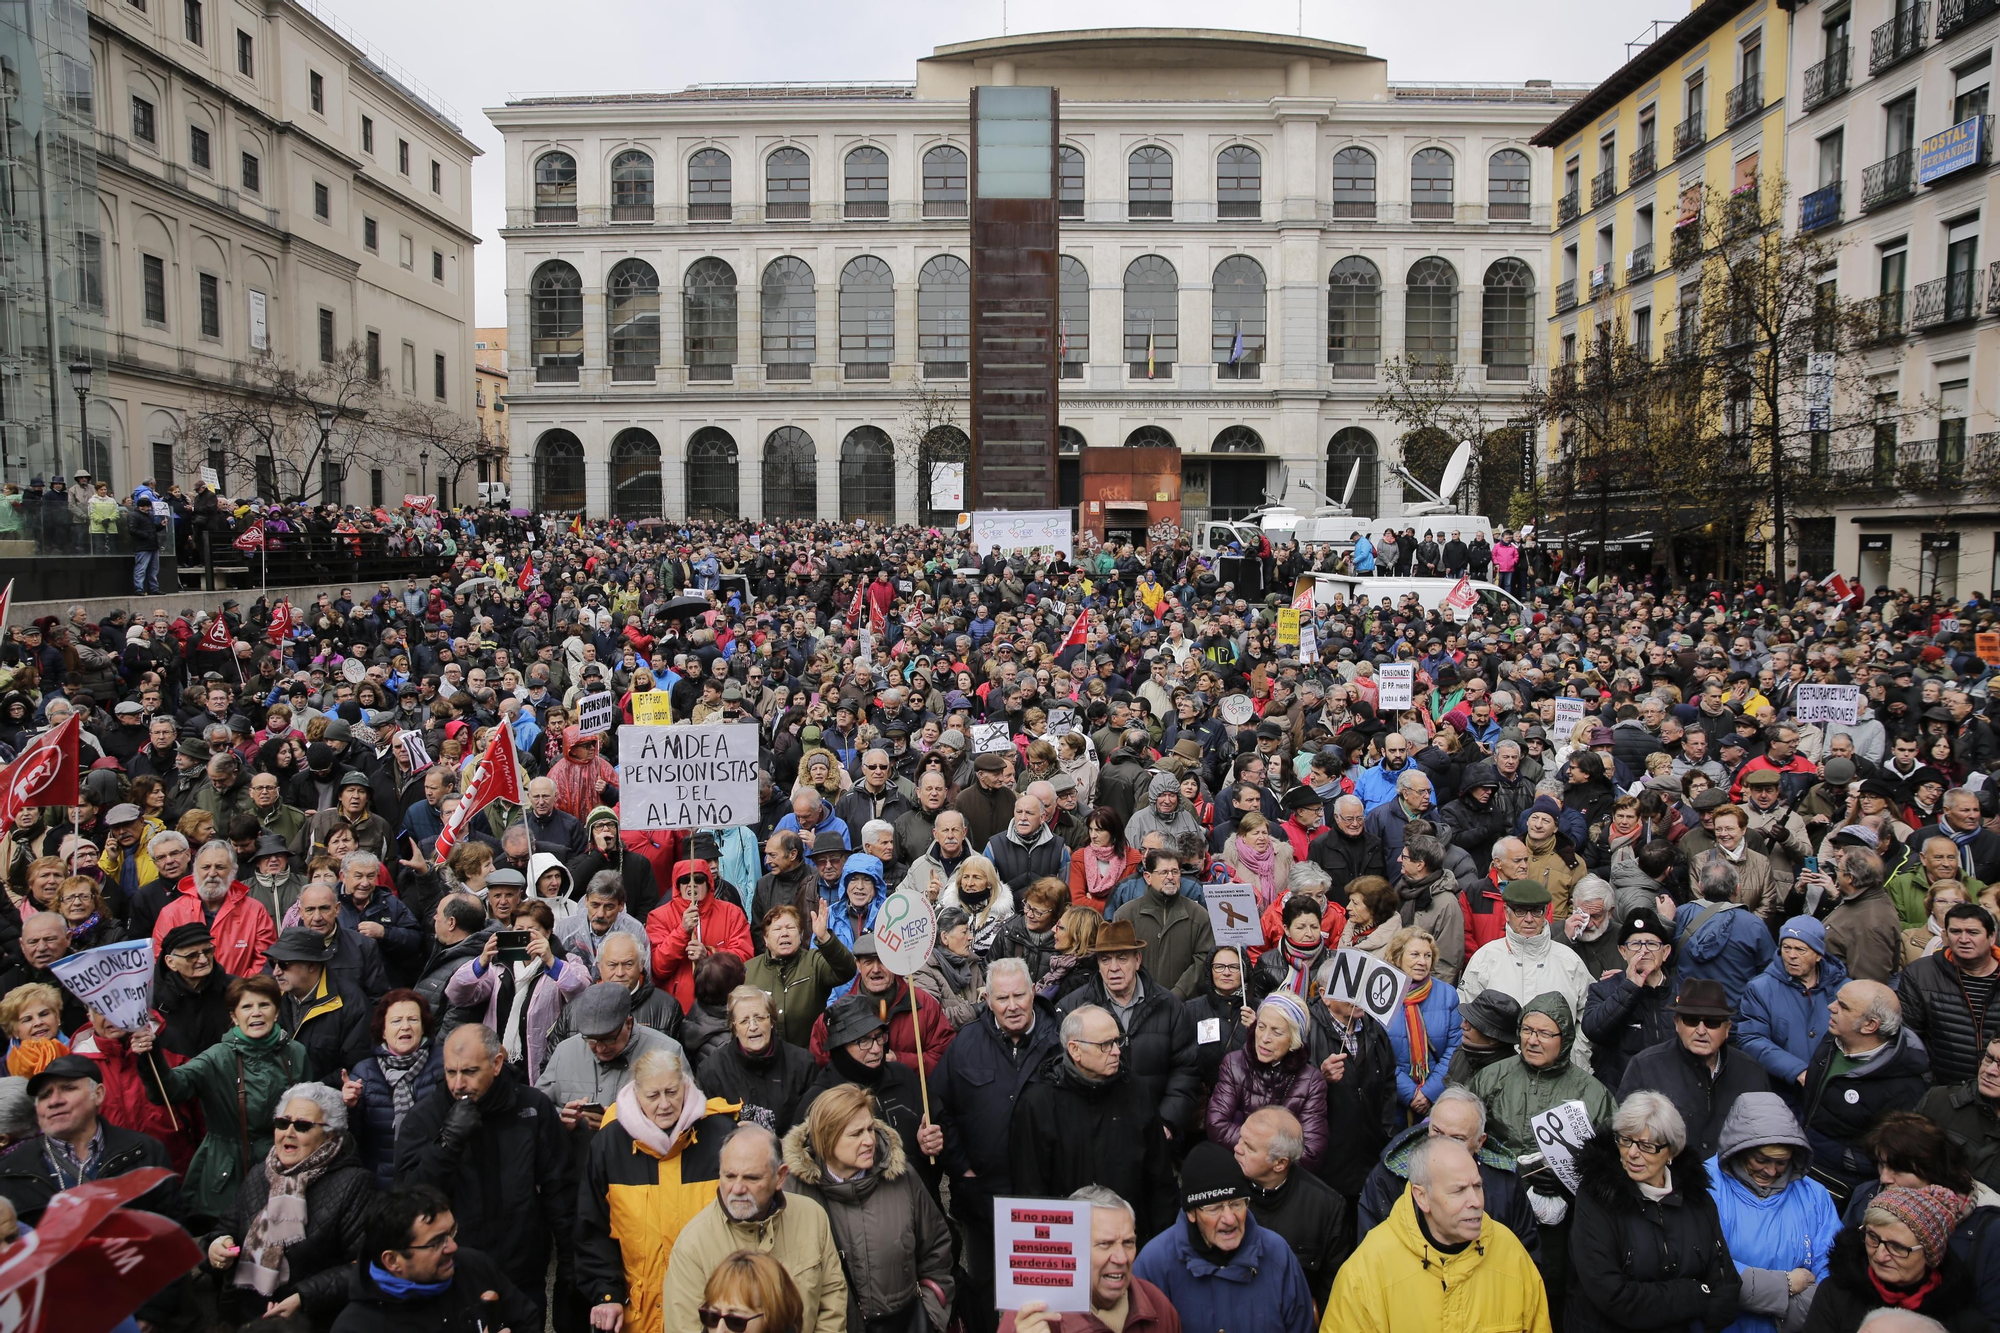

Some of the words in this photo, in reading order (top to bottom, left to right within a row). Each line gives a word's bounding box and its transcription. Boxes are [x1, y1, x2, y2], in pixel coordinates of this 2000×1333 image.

[1922, 125, 1968, 155] HOSTAL
[1922, 139, 1974, 170] FERNANDEZ
[1126, 401, 1168, 409] SUPERIOR
[1172, 401, 1183, 409] DE
[1223, 401, 1234, 409] DE
[1237, 401, 1274, 409] MADRID
[1800, 688, 1830, 700] RESTAURAR
[1830, 688, 1837, 700] EL
[1840, 688, 1857, 701] VALOR
[580, 695, 611, 715] ¡PENSIÓN
[642, 713, 652, 724] gran
[1799, 706, 1806, 719] DE
[1808, 706, 1819, 719] LAS
[580, 717, 601, 731] JUSTA
[625, 760, 758, 785] PENSIONISTAS
[675, 785, 717, 800] DEL
[647, 802, 732, 826] ALAMO
[901, 917, 928, 941] MERP
[1328, 952, 1398, 1015] NO
[1564, 1105, 1572, 1115] ES
[1573, 1107, 1582, 1116] SU
[1549, 1156, 1558, 1166] no
[1556, 1166, 1569, 1180] hay
[1187, 1187, 1235, 1203] GREENPEACE
[1011, 1211, 1020, 1220] Si
[1041, 1214, 1073, 1223] pagas
[1035, 1227, 1050, 1237] las
[1013, 1243, 1072, 1254] pensiones,
[1010, 1258, 1058, 1268] perderás
[1062, 1259, 1076, 1268] las
[1013, 1274, 1073, 1285] elecciones.
